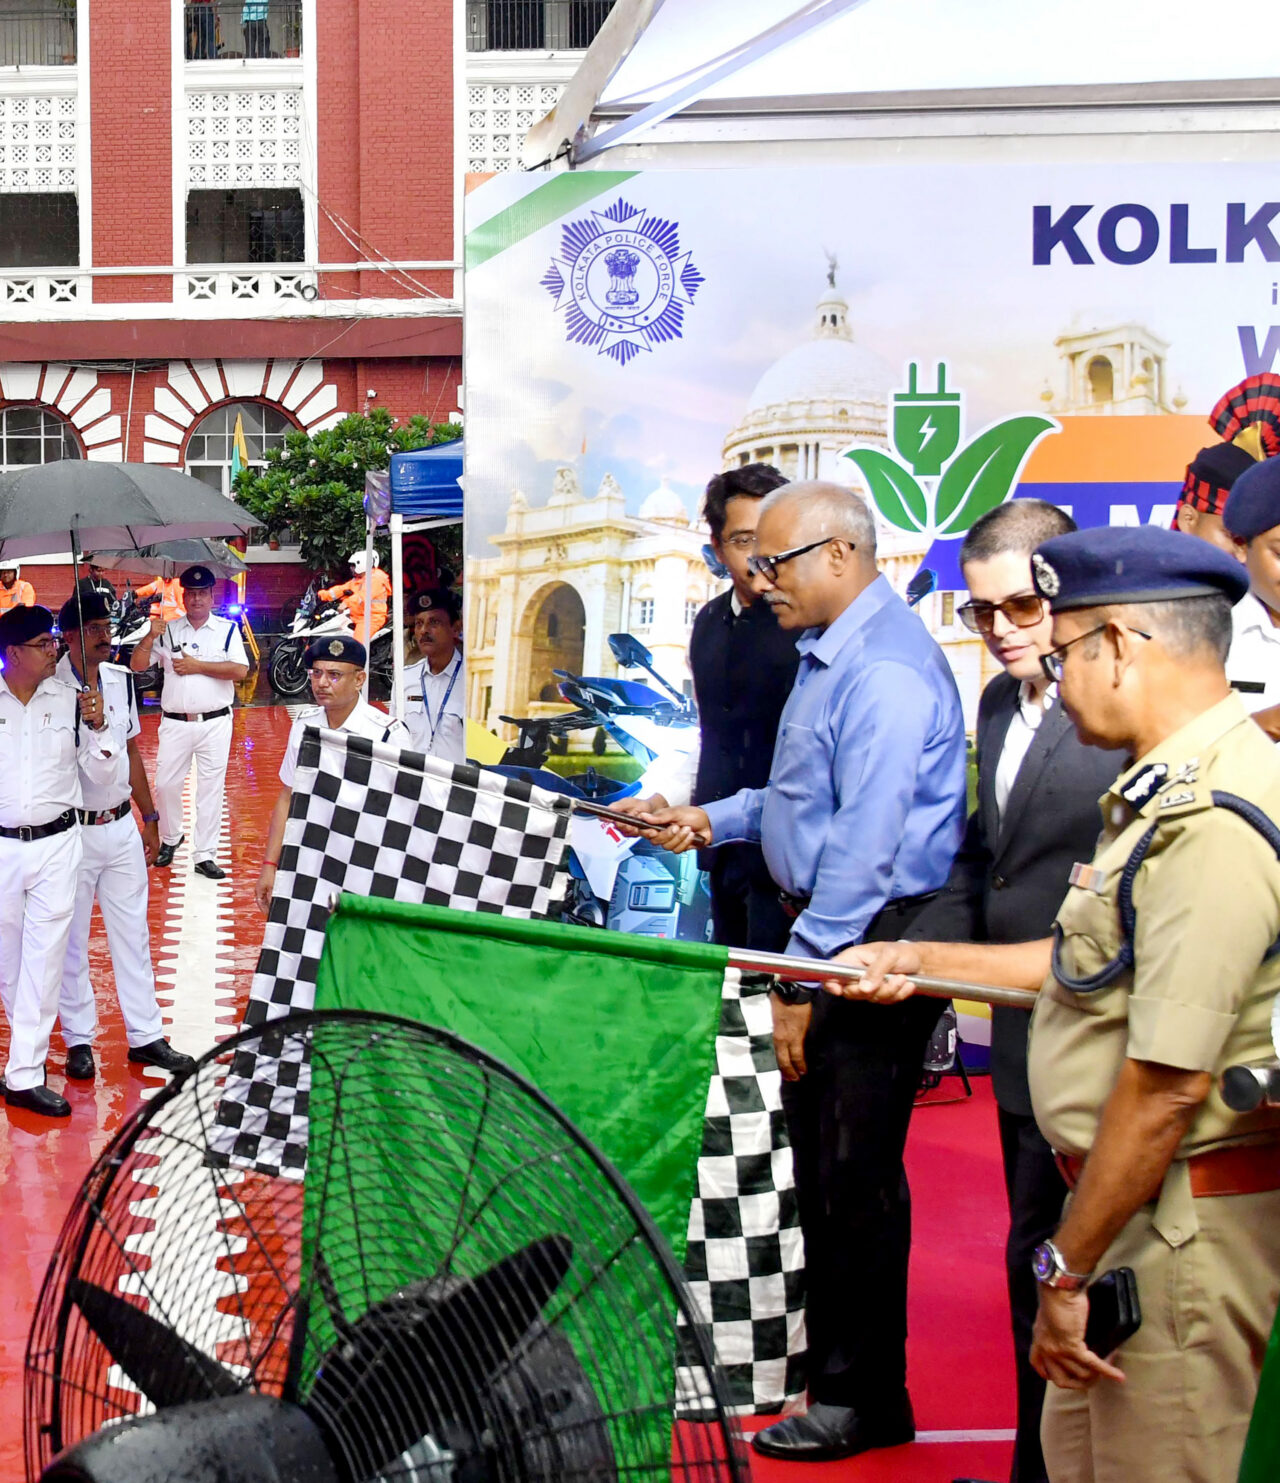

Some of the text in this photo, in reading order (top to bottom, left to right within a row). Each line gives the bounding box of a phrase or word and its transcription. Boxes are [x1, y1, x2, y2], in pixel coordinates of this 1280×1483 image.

[1032, 202, 1280, 265] KOLK
[575, 234, 670, 301] KOLKATA POLICE FORCE
